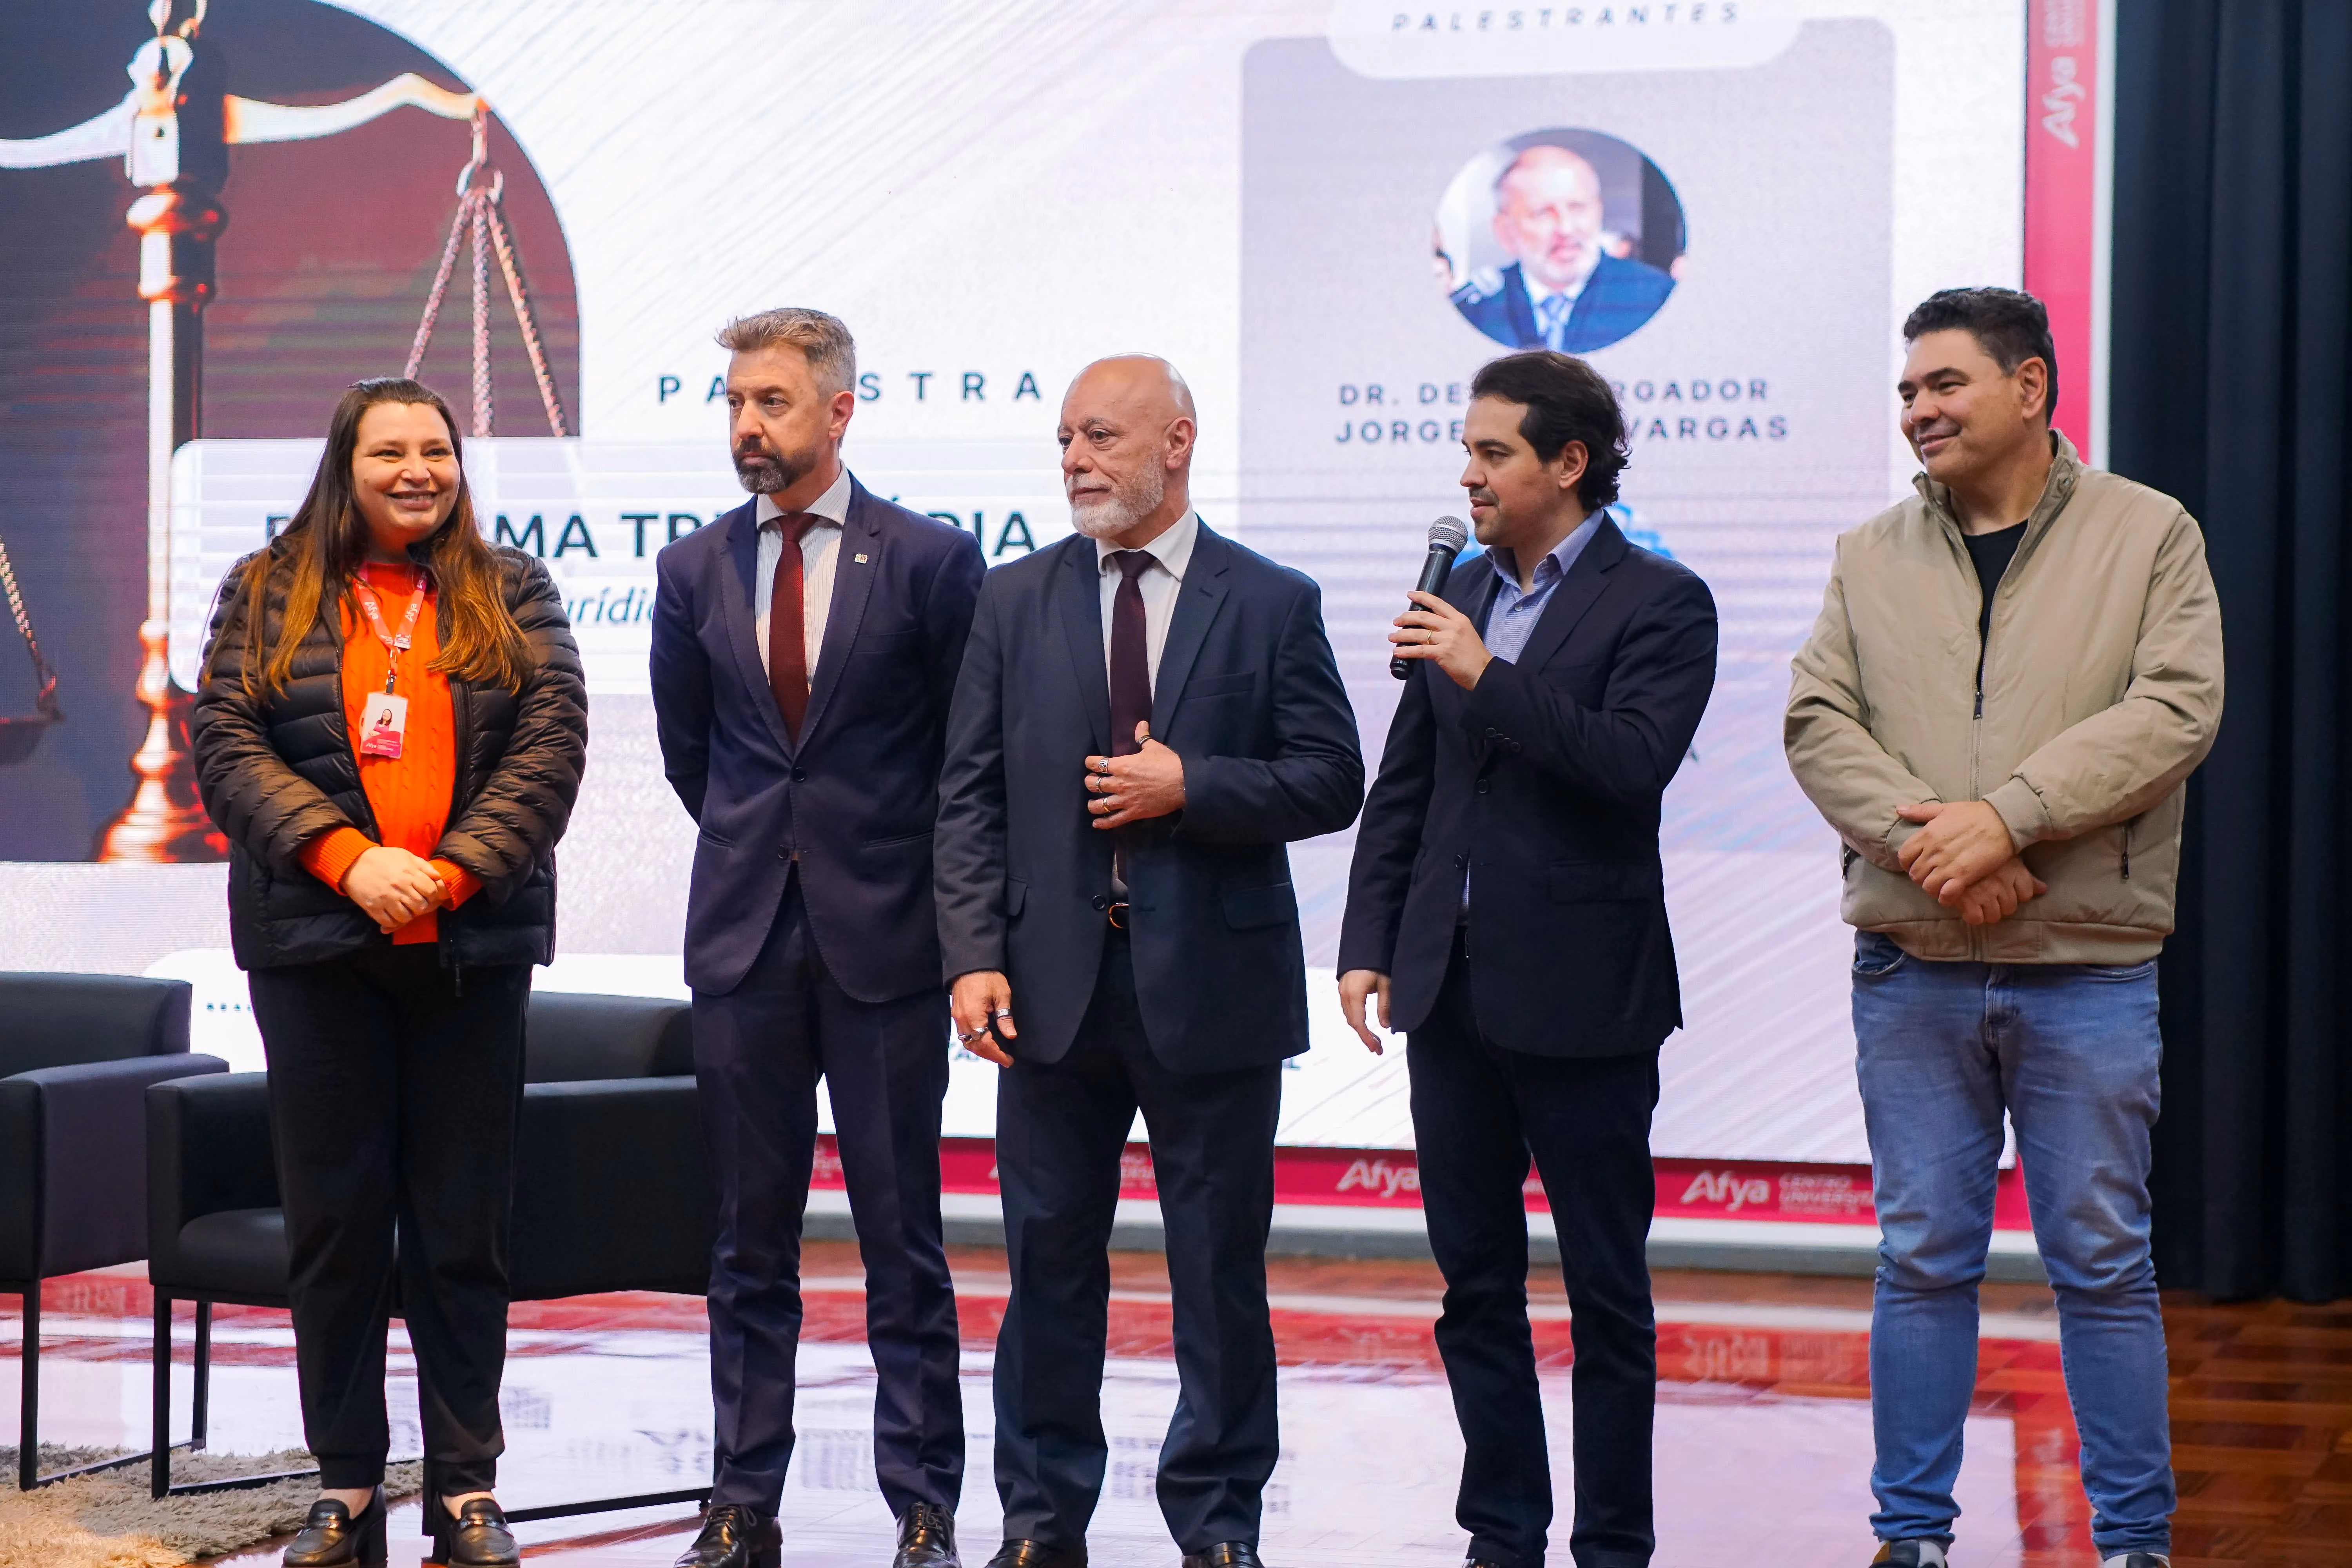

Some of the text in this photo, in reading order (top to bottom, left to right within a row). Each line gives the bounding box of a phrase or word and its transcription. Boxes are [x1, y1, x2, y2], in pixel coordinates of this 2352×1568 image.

[1392, 3, 1738, 32] PALESTRANTES
[659, 372, 1041, 402] PASTRA
[1340, 383, 1399, 405] DR.
[1336, 420, 1464, 443] JORGE
[1680, 1170, 1771, 1212] Afya
